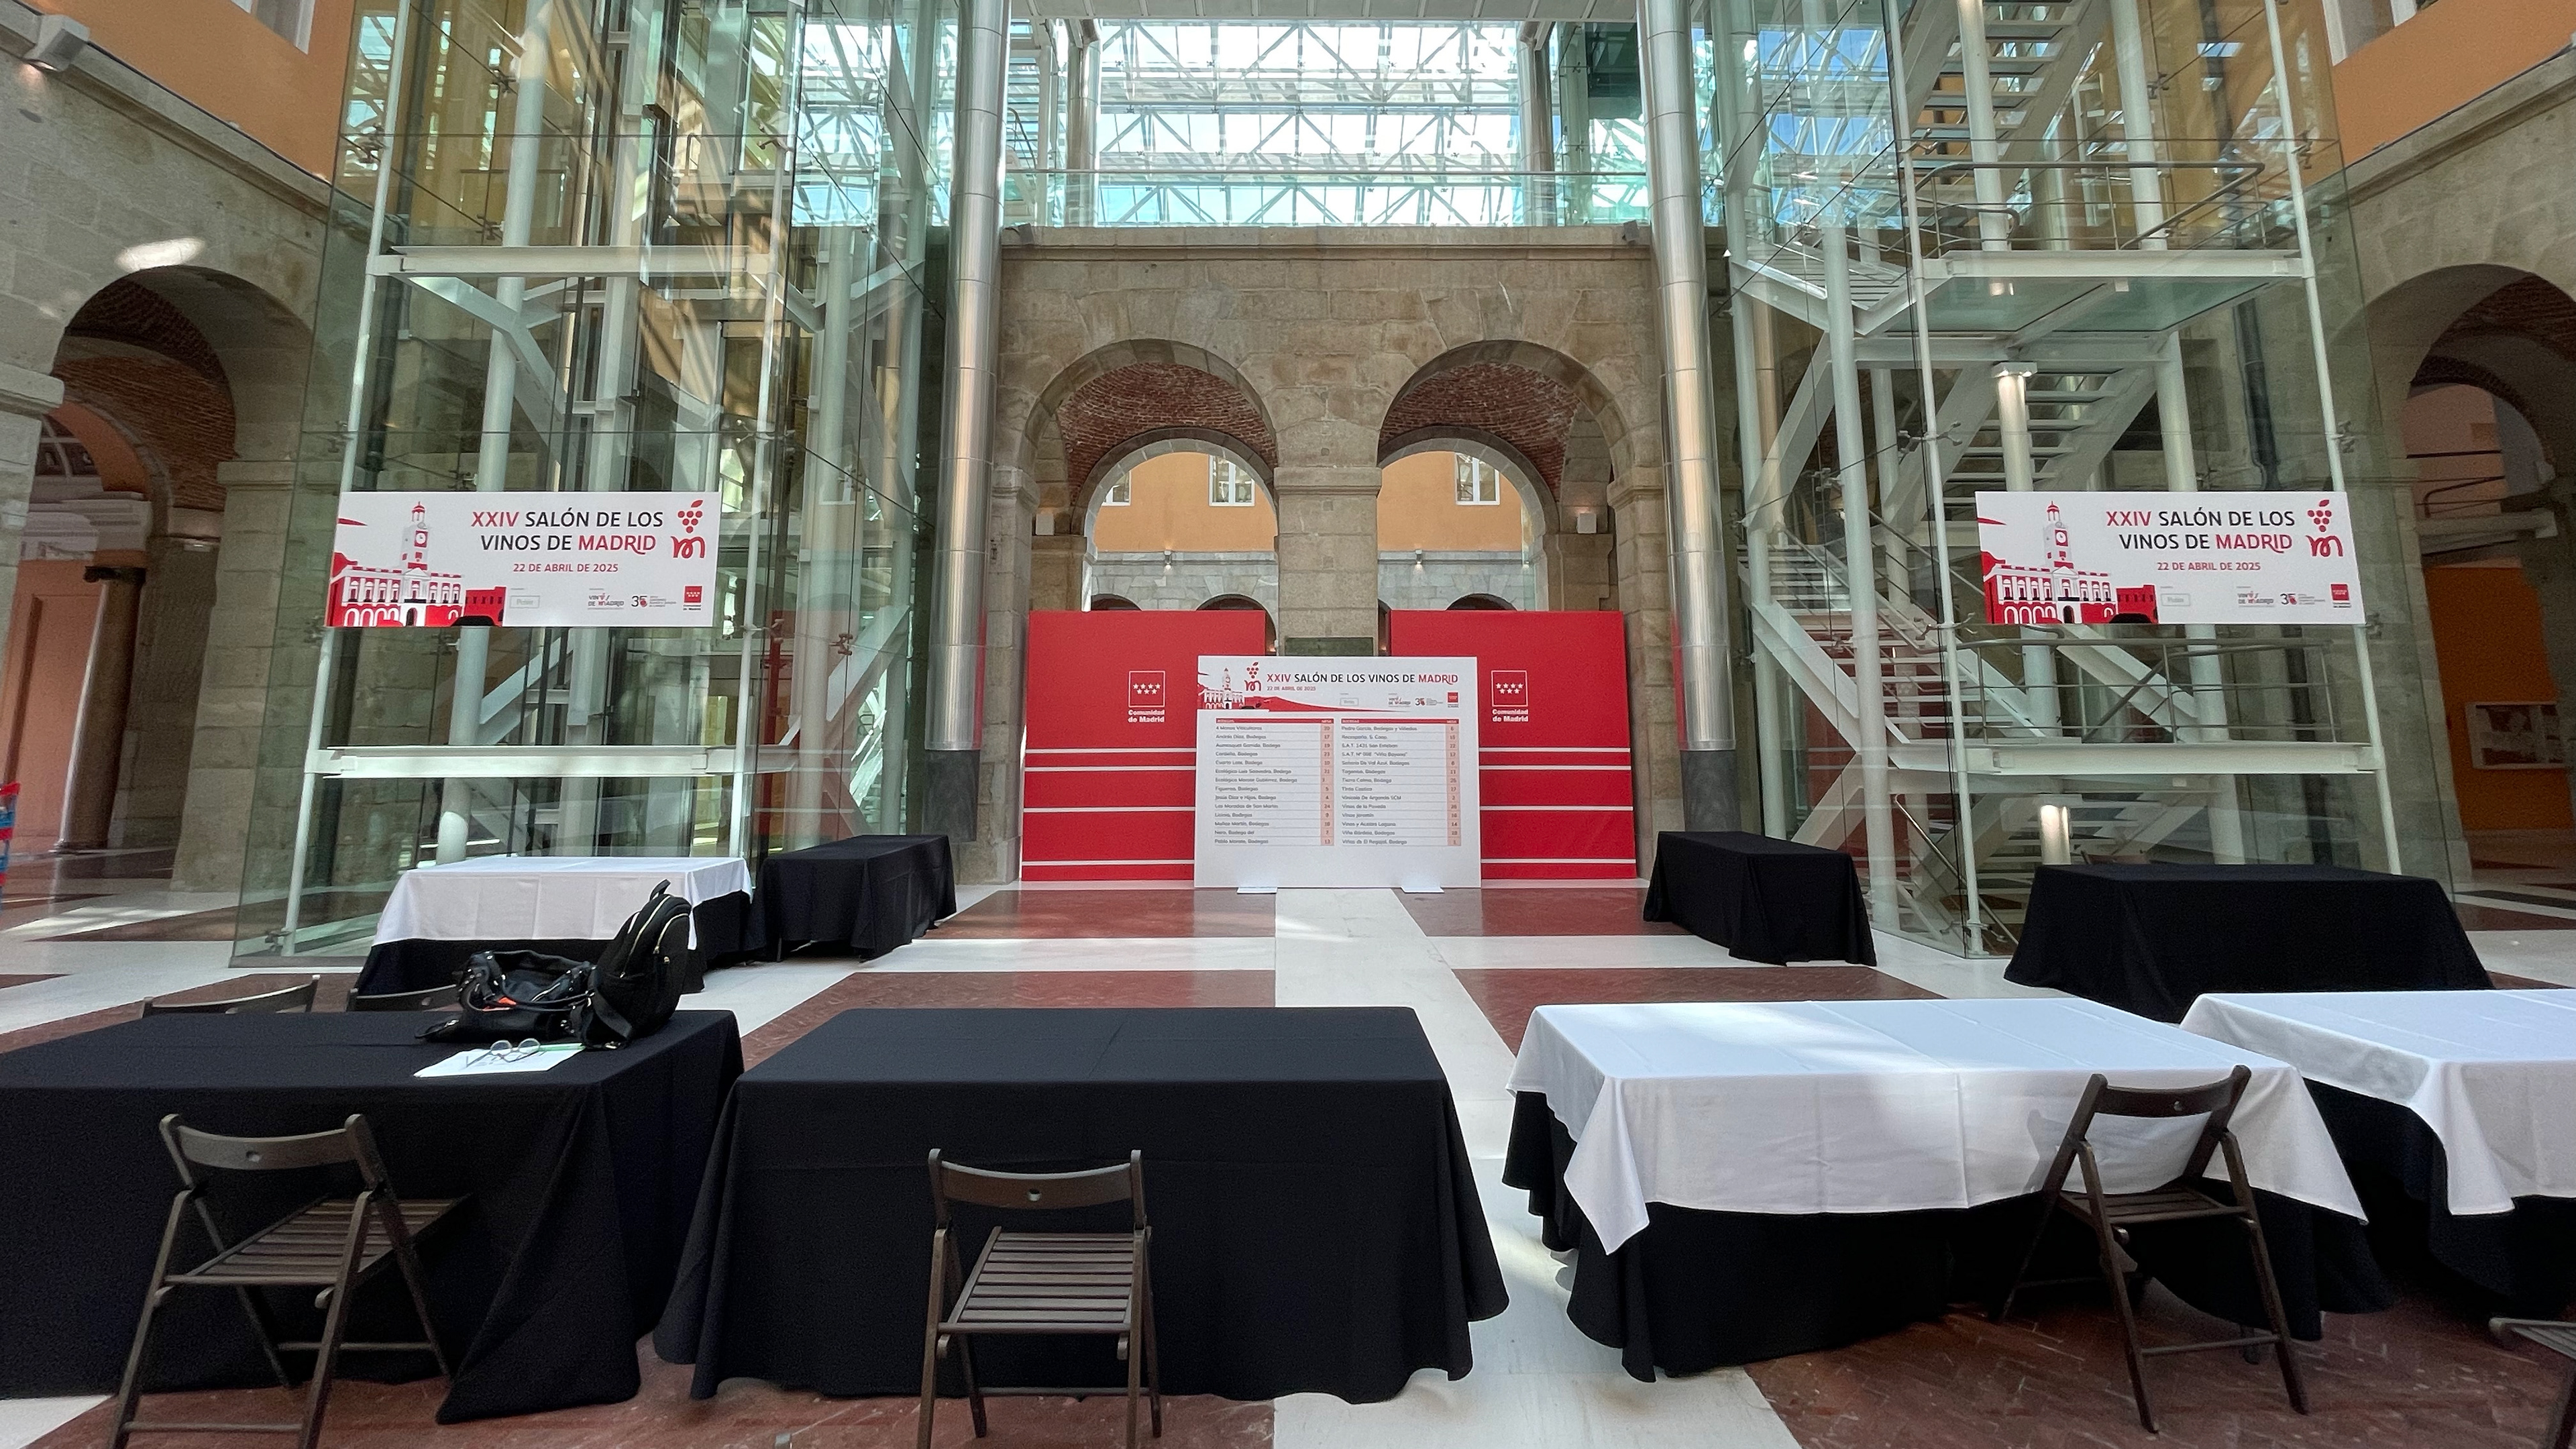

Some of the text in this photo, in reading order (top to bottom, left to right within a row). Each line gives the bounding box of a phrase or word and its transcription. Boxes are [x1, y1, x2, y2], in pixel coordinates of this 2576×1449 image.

[470, 506, 663, 528] XXIV SALÓN DE LOS
[2105, 506, 2296, 527] XXIV SALÓN DE LOS
[480, 535, 656, 555] VINOS DE MADRID
[2118, 533, 2293, 554] VINOS DE MADRID
[513, 563, 619, 572] 22 DE ABRIL DE 2025
[2157, 561, 2261, 571] 22 DE ABRIL DE 2025
[1267, 671, 1458, 686] XXIV SALÓN DE LOS VINOS DE MADRID
